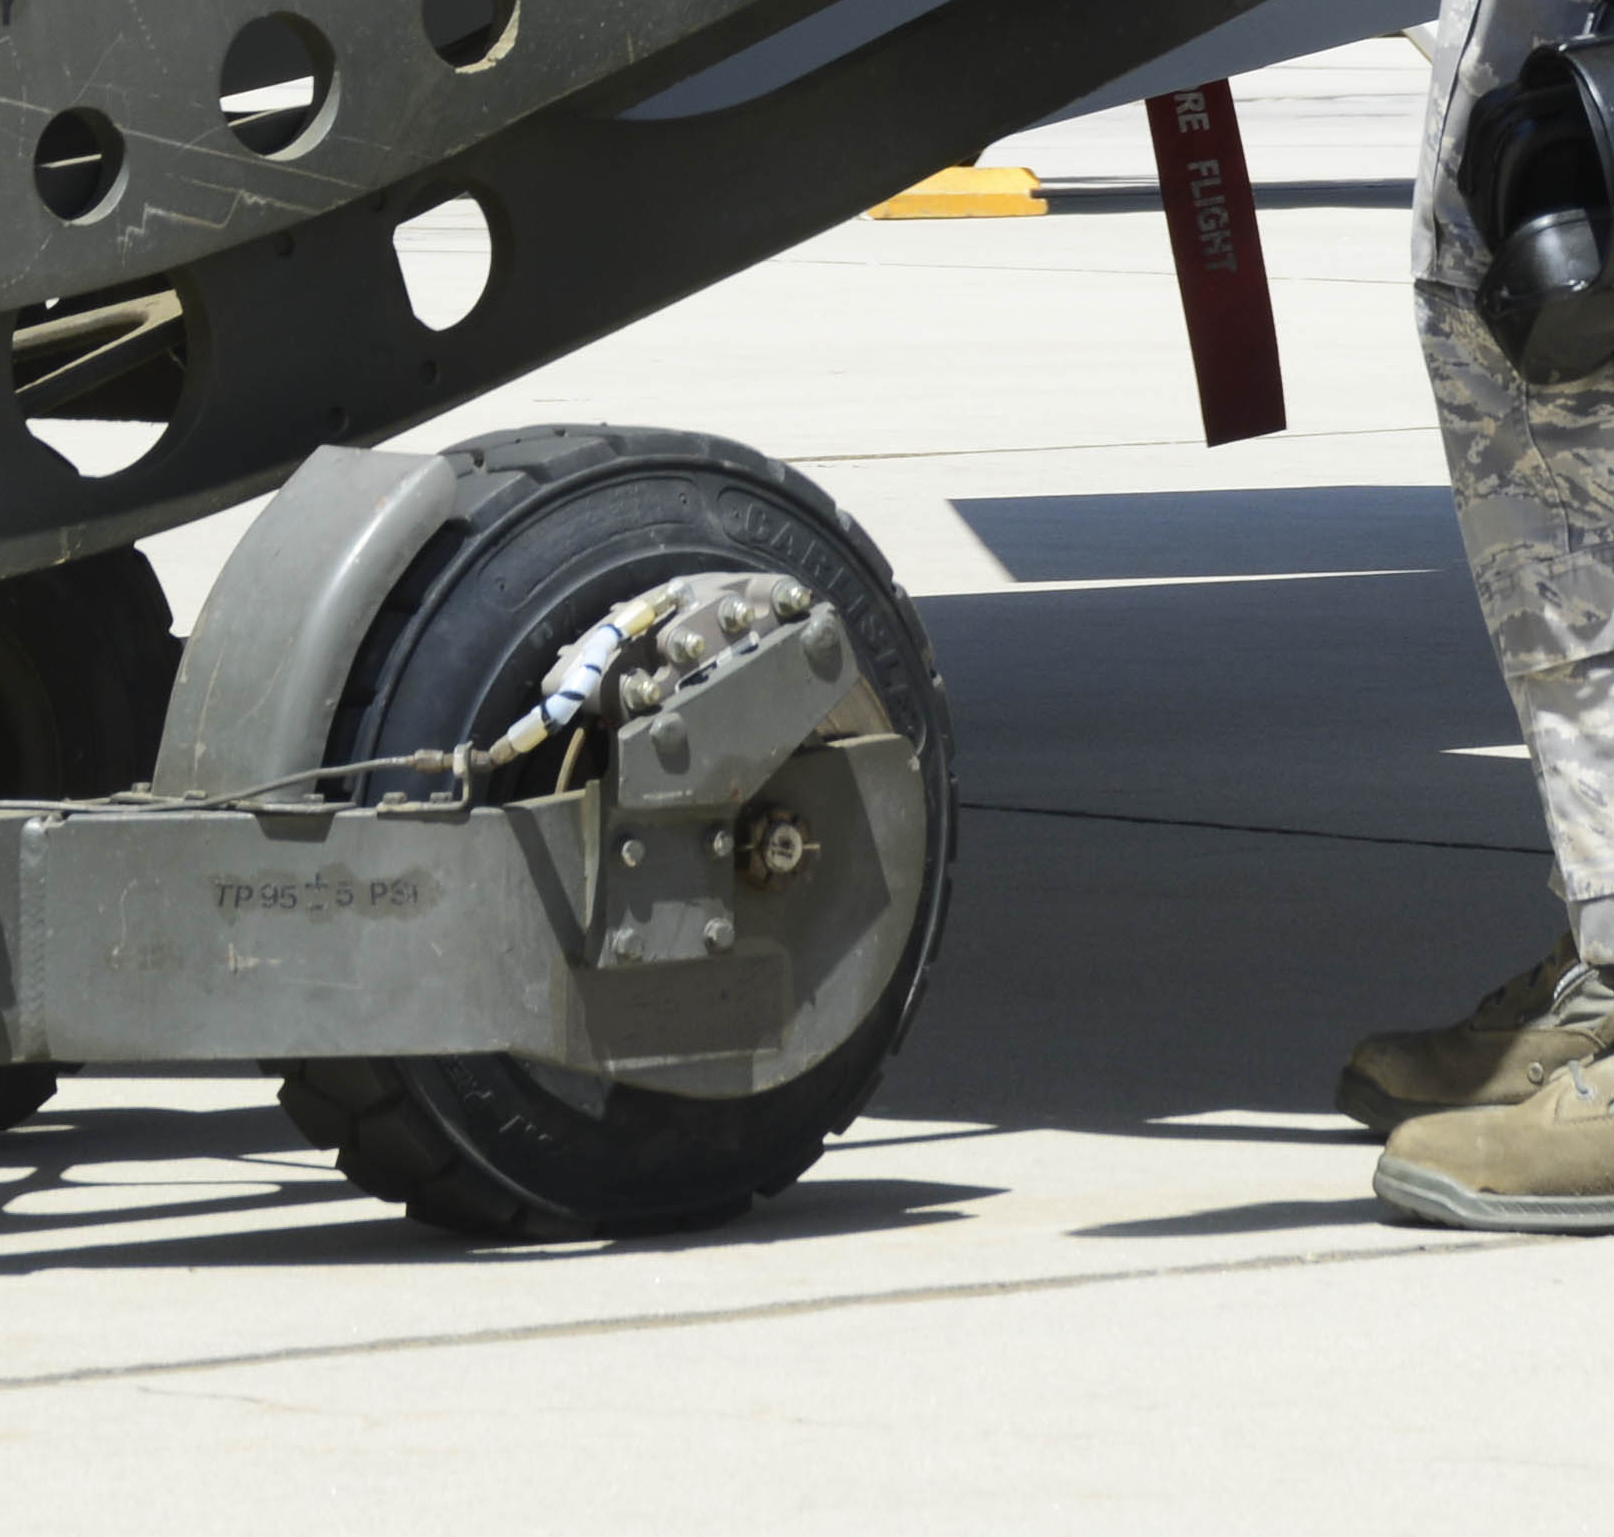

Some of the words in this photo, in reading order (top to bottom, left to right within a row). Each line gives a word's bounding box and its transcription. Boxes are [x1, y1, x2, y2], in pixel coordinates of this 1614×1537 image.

[1188, 158, 1238, 273] FLIGHT
[215, 881, 254, 909] TP
[260, 881, 297, 910] 95
